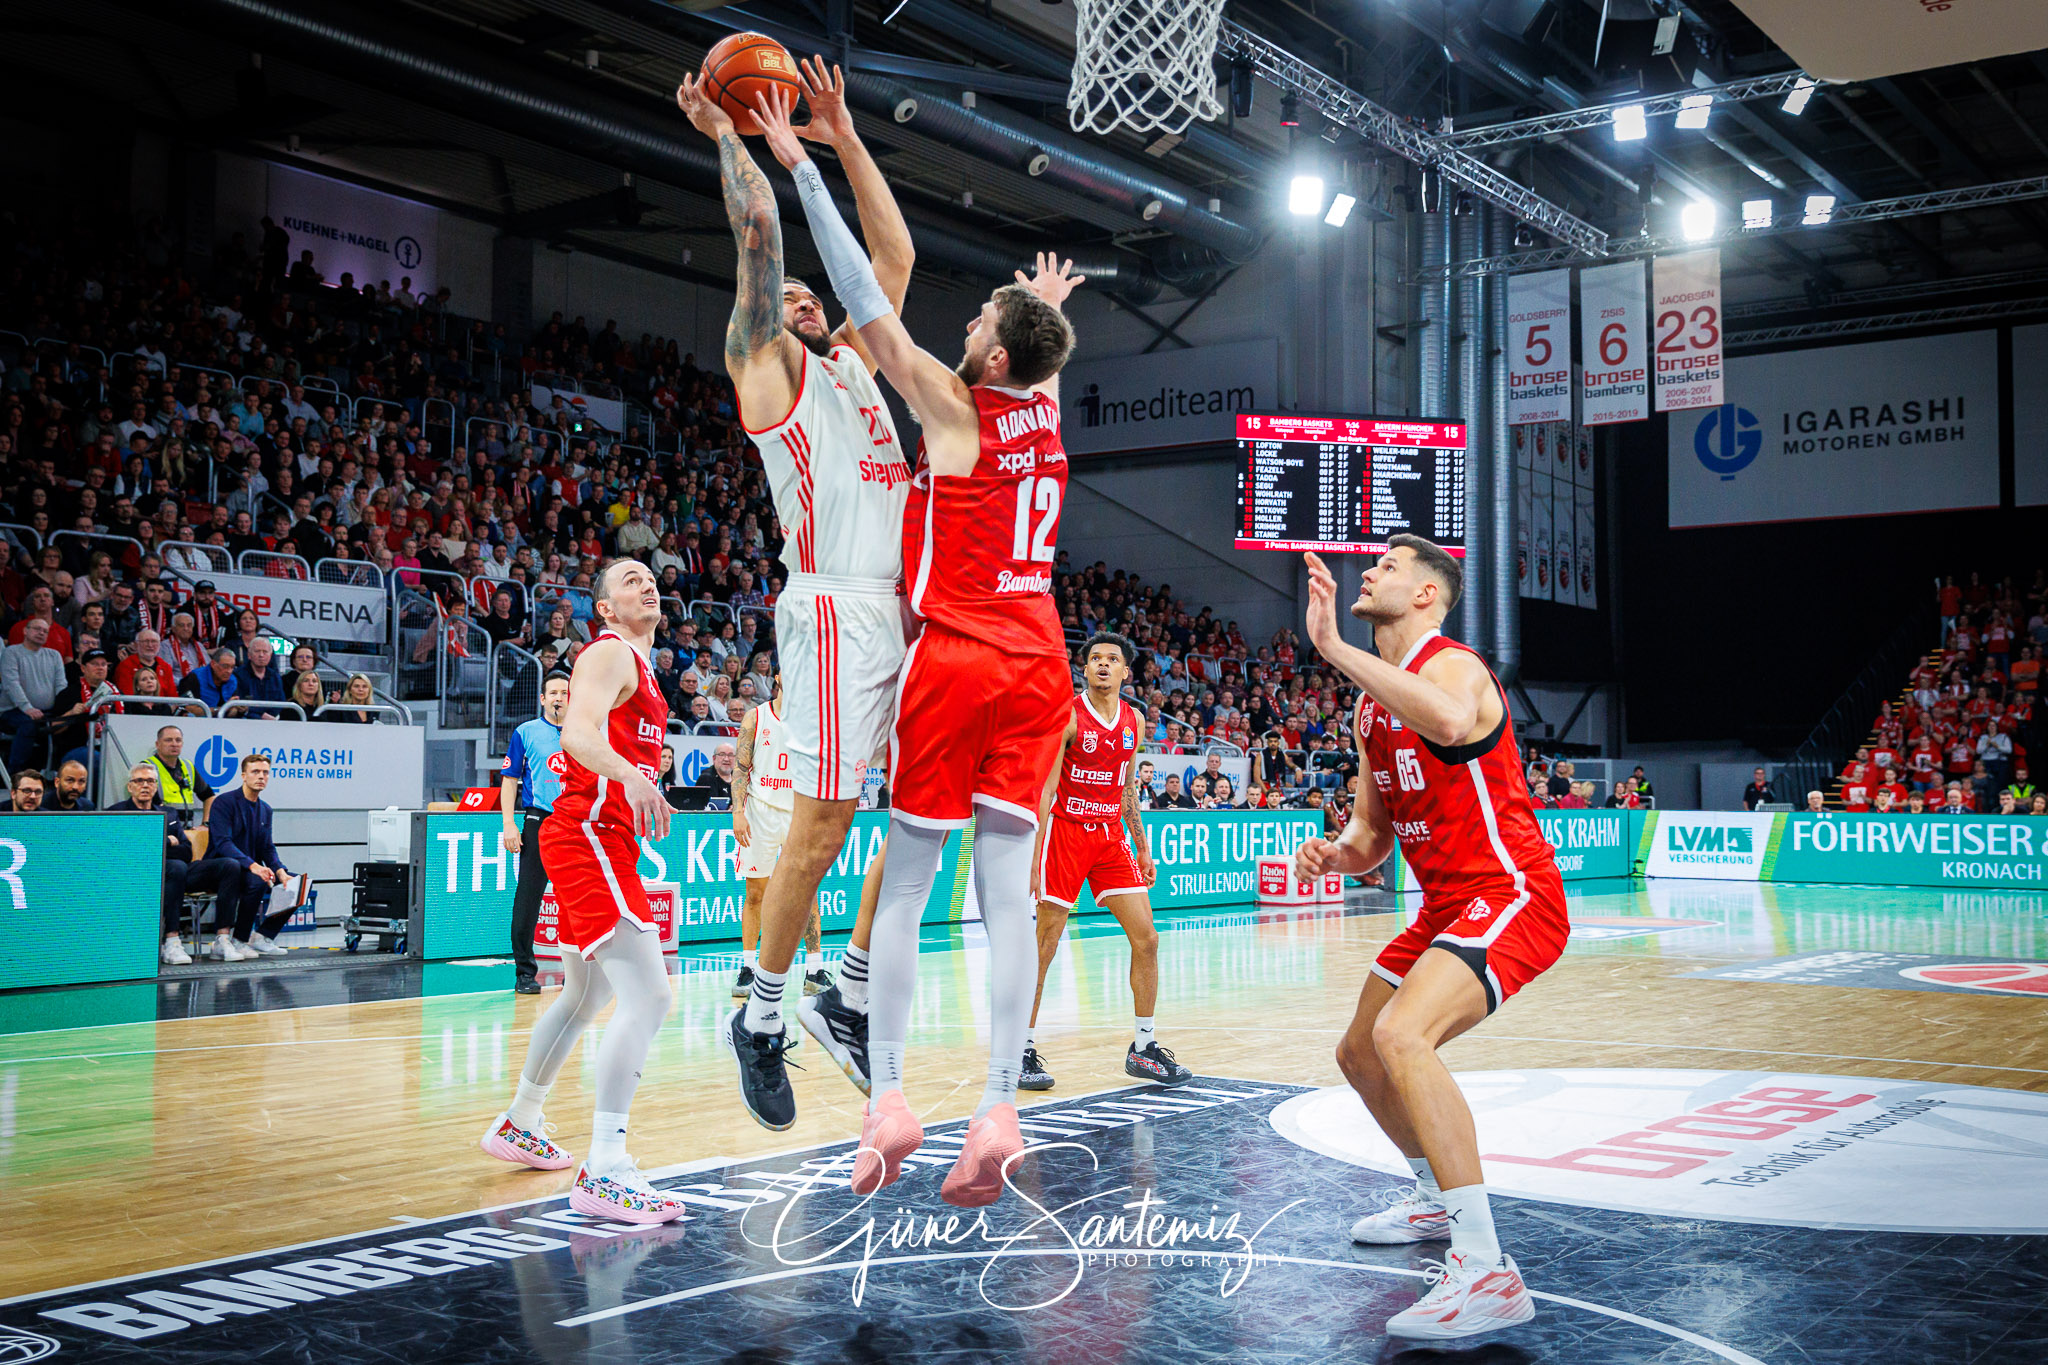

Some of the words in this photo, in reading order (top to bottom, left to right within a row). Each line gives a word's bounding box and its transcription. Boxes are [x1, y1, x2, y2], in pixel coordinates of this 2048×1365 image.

[284, 216, 391, 254] KUEHNE+NAGEL
[1659, 290, 1715, 305] JACOBSEN
[1508, 308, 1568, 323] GOLDSBERRY
[1600, 307, 1626, 318] ZISIS
[1656, 305, 1719, 353] 23
[1525, 324, 1552, 366] 5
[1599, 323, 1628, 366] 6
[1656, 354, 1720, 371] brose
[1509, 370, 1568, 387] brose
[1584, 368, 1645, 387] brose
[1657, 369, 1720, 385] baskets
[1509, 384, 1568, 401] baskets
[1584, 383, 1645, 399] bamberg
[1665, 386, 1712, 397] 2006-2007
[1666, 396, 1713, 407] 2009-2014
[1519, 410, 1559, 421] 2008-2014
[1593, 409, 1638, 421] 2015-2019
[1783, 396, 1965, 435] IGARASHI
[1246, 416, 1261, 430] 15
[1269, 418, 1302, 426] BAMBERG
[1302, 419, 1333, 428] BASKETS
[1374, 422, 1402, 431] BAYERN
[1443, 425, 1459, 438] 15
[1255, 441, 1283, 450] LOFTON
[1783, 432, 1890, 455] MOTOREN
[1898, 425, 1965, 445] GMBH
[996, 446, 1036, 475] xpd
[1255, 449, 1278, 458] LOCKE
[1254, 498, 1287, 507] HORVATH
[1012, 475, 1060, 563] 12
[1324, 544, 1355, 552] BASKETS
[277, 598, 374, 625] ARENA
[638, 717, 662, 742] bro
[778, 753, 788, 771] 0
[1395, 748, 1426, 792] 65
[271, 767, 313, 779] TOREN
[317, 768, 352, 779] GMBH
[1070, 764, 1113, 781] brose
[760, 774, 793, 790] siegm
[1567, 817, 1620, 849] KRAHM
[1668, 826, 1725, 852] LVM
[1793, 812, 2034, 856] FÖHRWEISER
[1146, 823, 1210, 866] LGER
[1669, 853, 1753, 865] VERSICHERUNG
[1262, 865, 1285, 877] RHÖN
[1942, 861, 2042, 880] KRONACH
[1169, 871, 1255, 896] STRULLENDO
[538, 899, 559, 916] RHÖ
[648, 898, 670, 912] HÖN
[536, 914, 559, 925] SPRUD
[652, 913, 670, 922] UDEL
[1481, 1086, 1878, 1179] brose
[1700, 1144, 1826, 1188] Technik
[1825, 1098, 1948, 1140] Automobile
[38, 1225, 573, 1340] BAMBERG
